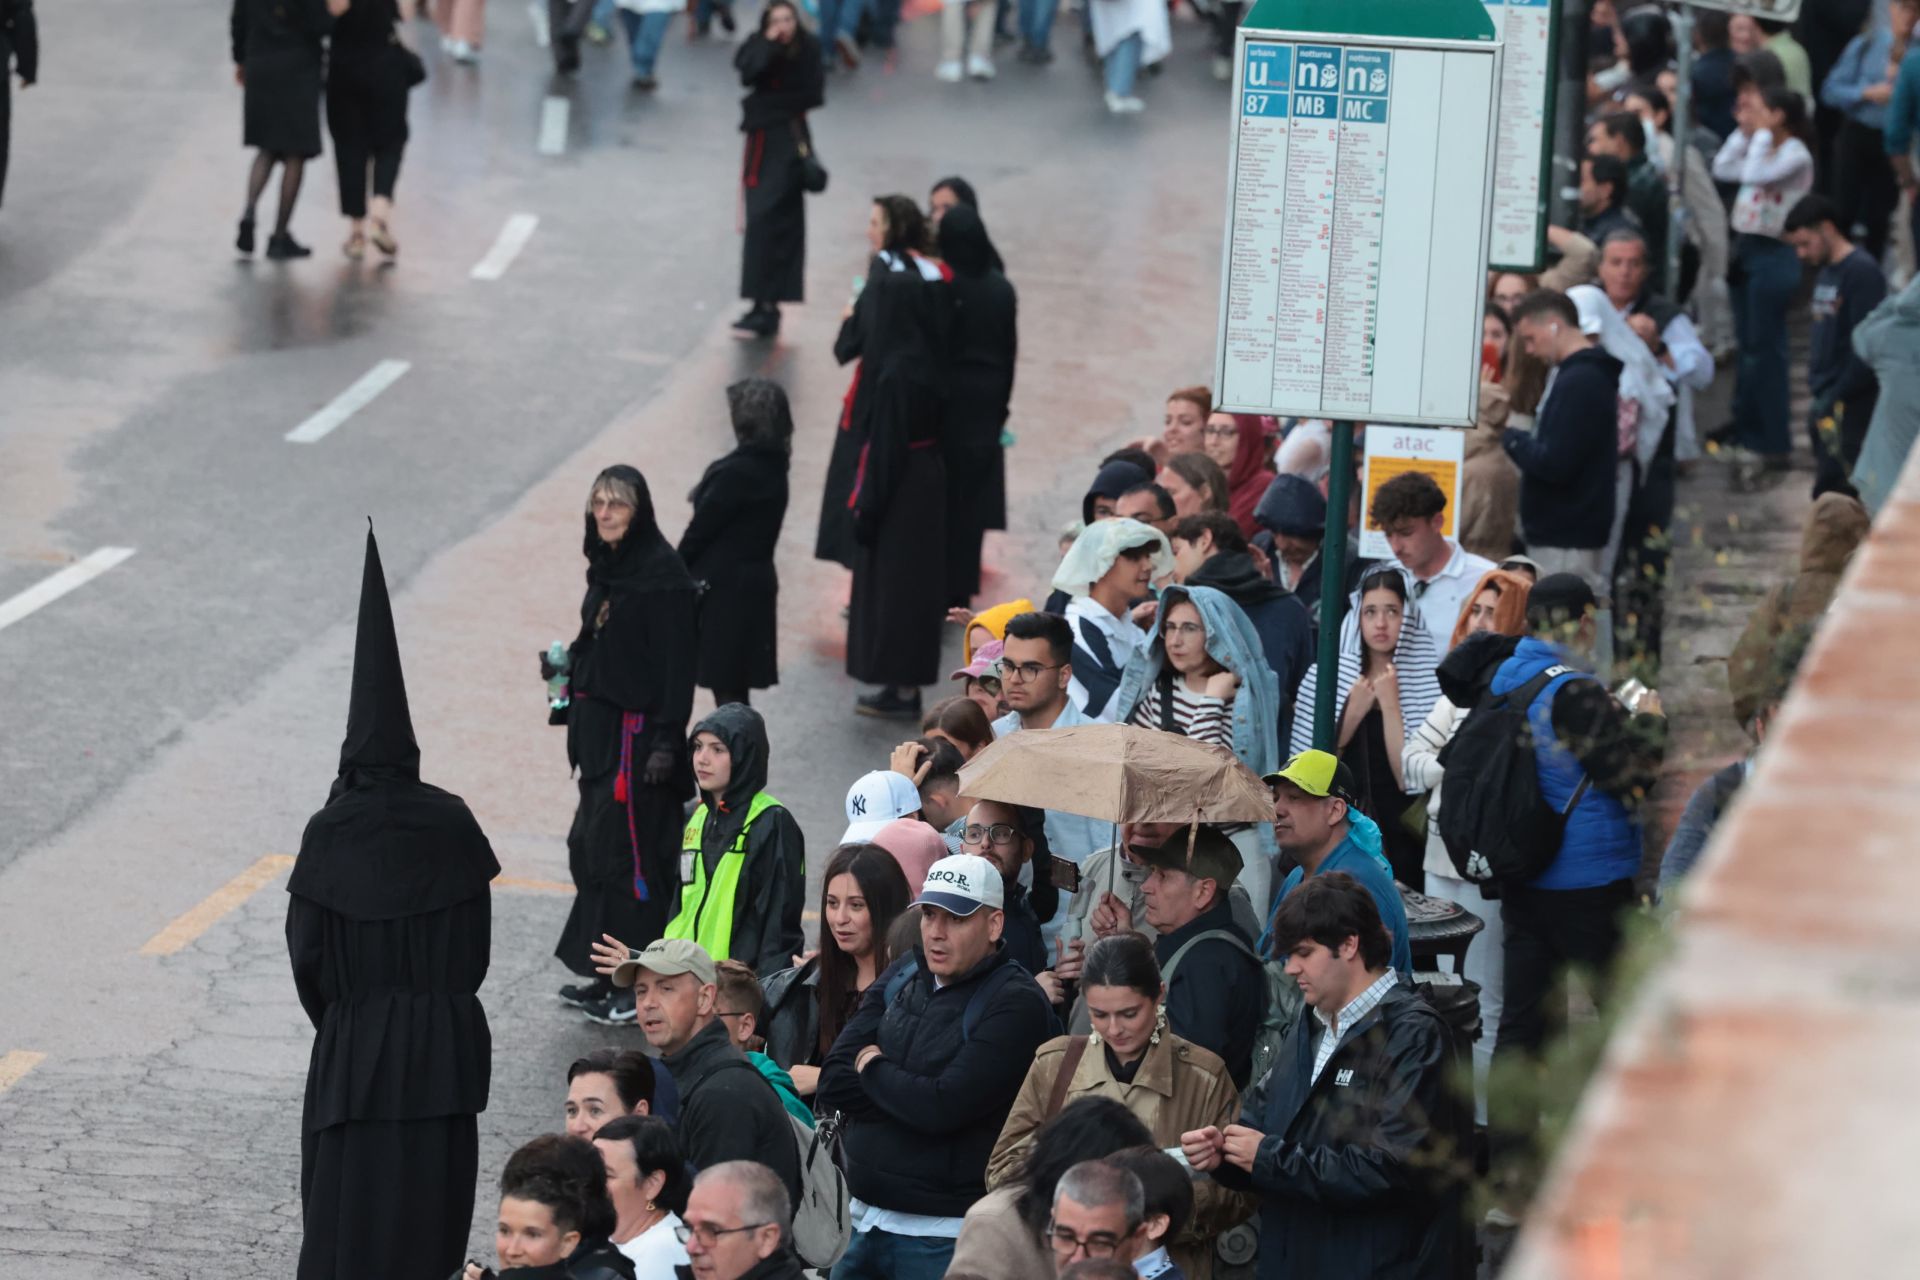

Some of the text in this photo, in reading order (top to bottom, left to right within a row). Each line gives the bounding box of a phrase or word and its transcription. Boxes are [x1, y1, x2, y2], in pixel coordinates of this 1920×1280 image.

[1250, 48, 1276, 57] urbana
[1299, 50, 1332, 59] notturna
[1349, 54, 1381, 63] notturna
[1249, 61, 1268, 86] u
[1246, 94, 1269, 114] 87
[1296, 96, 1325, 115] MB
[1345, 100, 1373, 120] MC
[1393, 436, 1435, 452] atac
